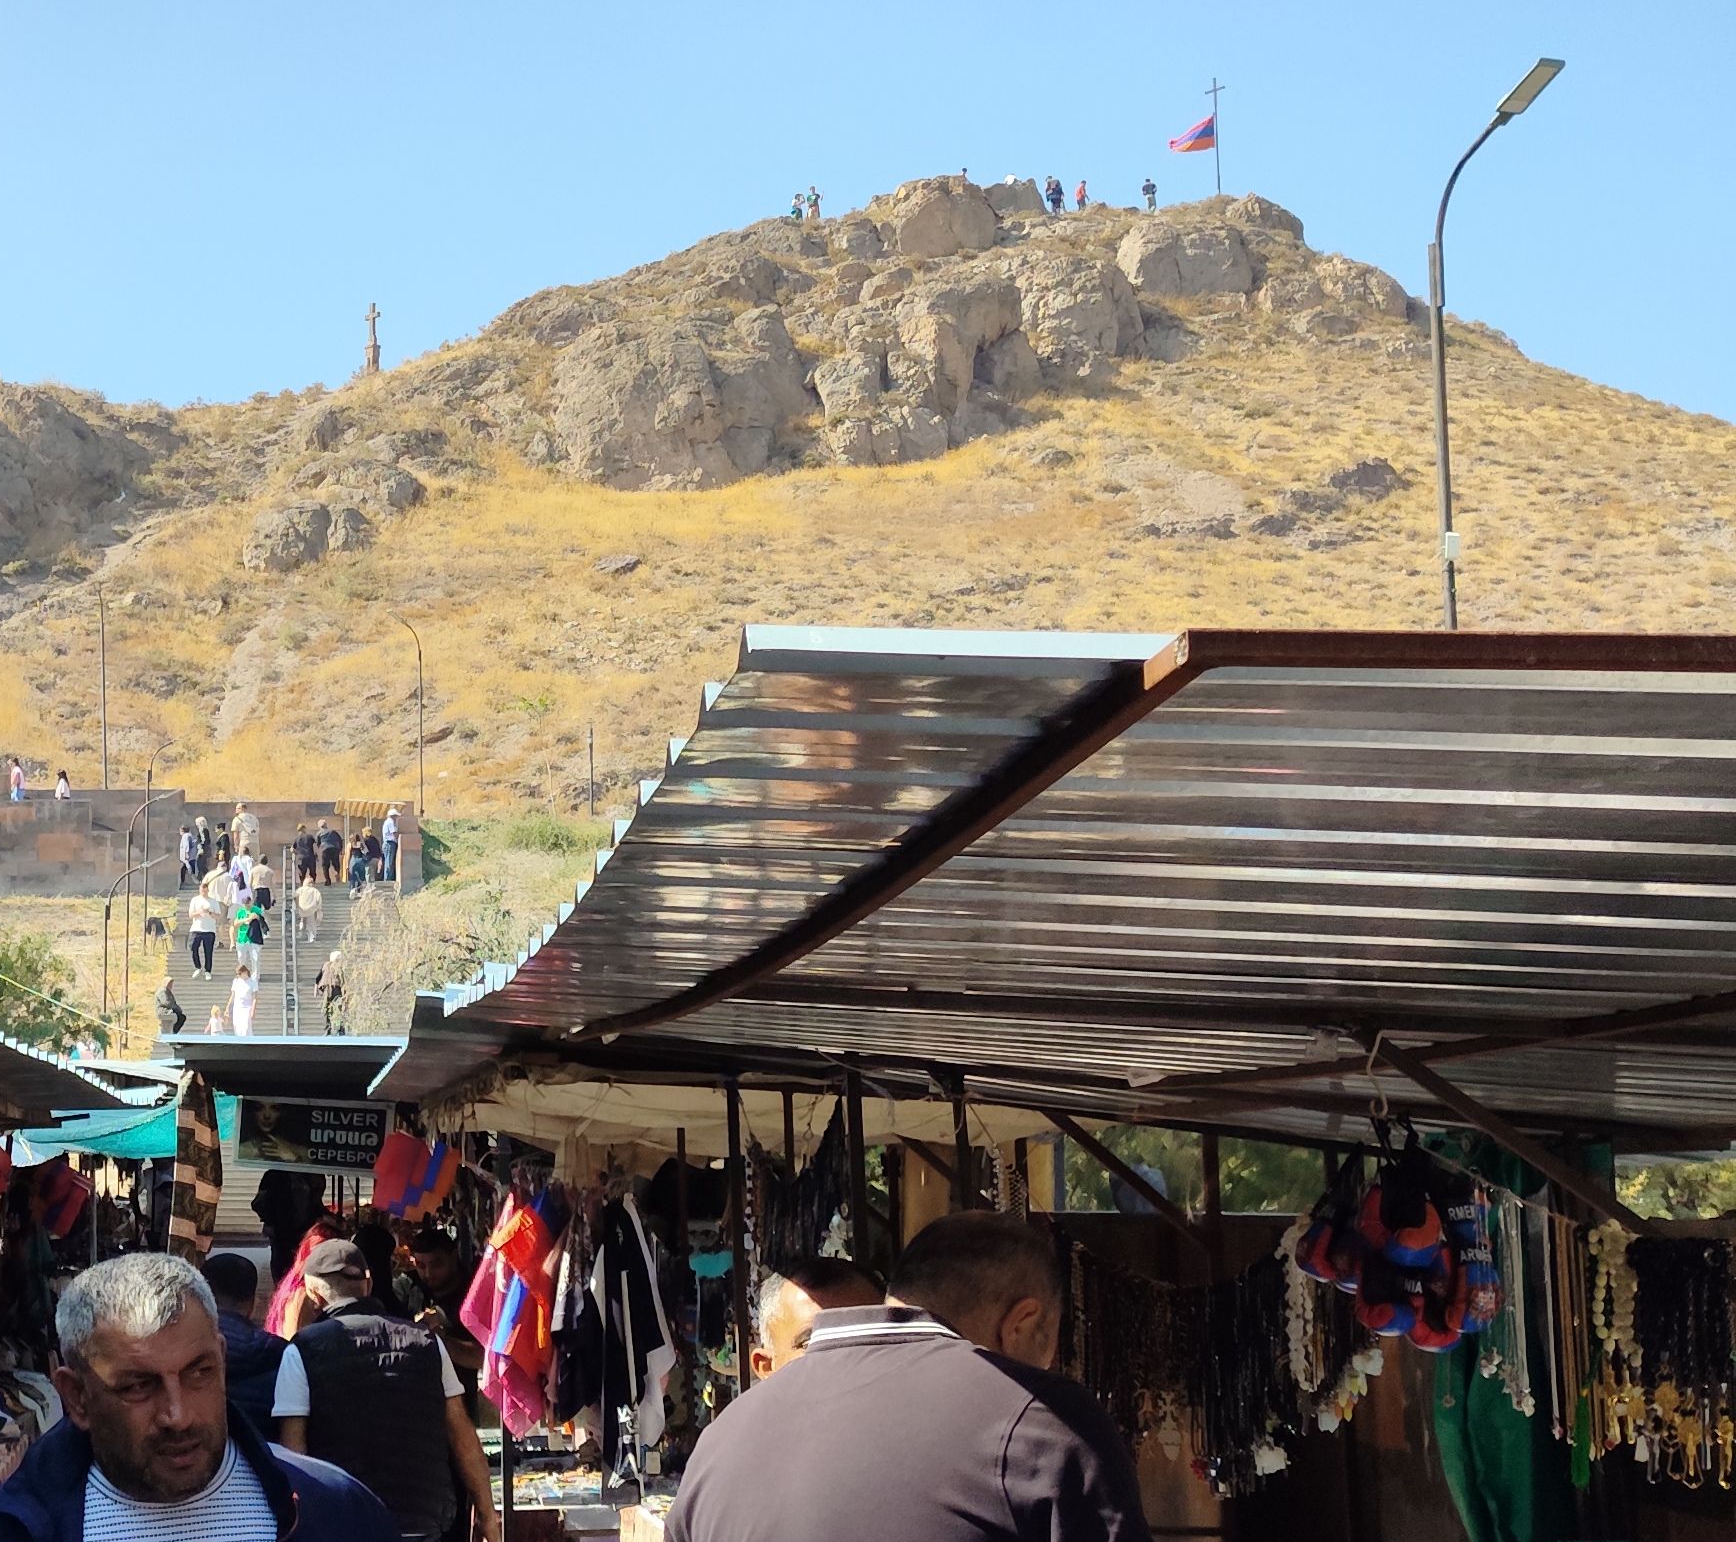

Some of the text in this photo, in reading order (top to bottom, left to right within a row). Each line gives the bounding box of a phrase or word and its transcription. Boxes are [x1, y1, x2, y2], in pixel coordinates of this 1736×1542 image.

[311, 1109, 379, 1128] SILVER
[310, 1128, 379, 1147] ԱՐԾԱԹ
[307, 1147, 377, 1164] СЕРЕБРО
[1403, 1276, 1424, 1295] NIA
